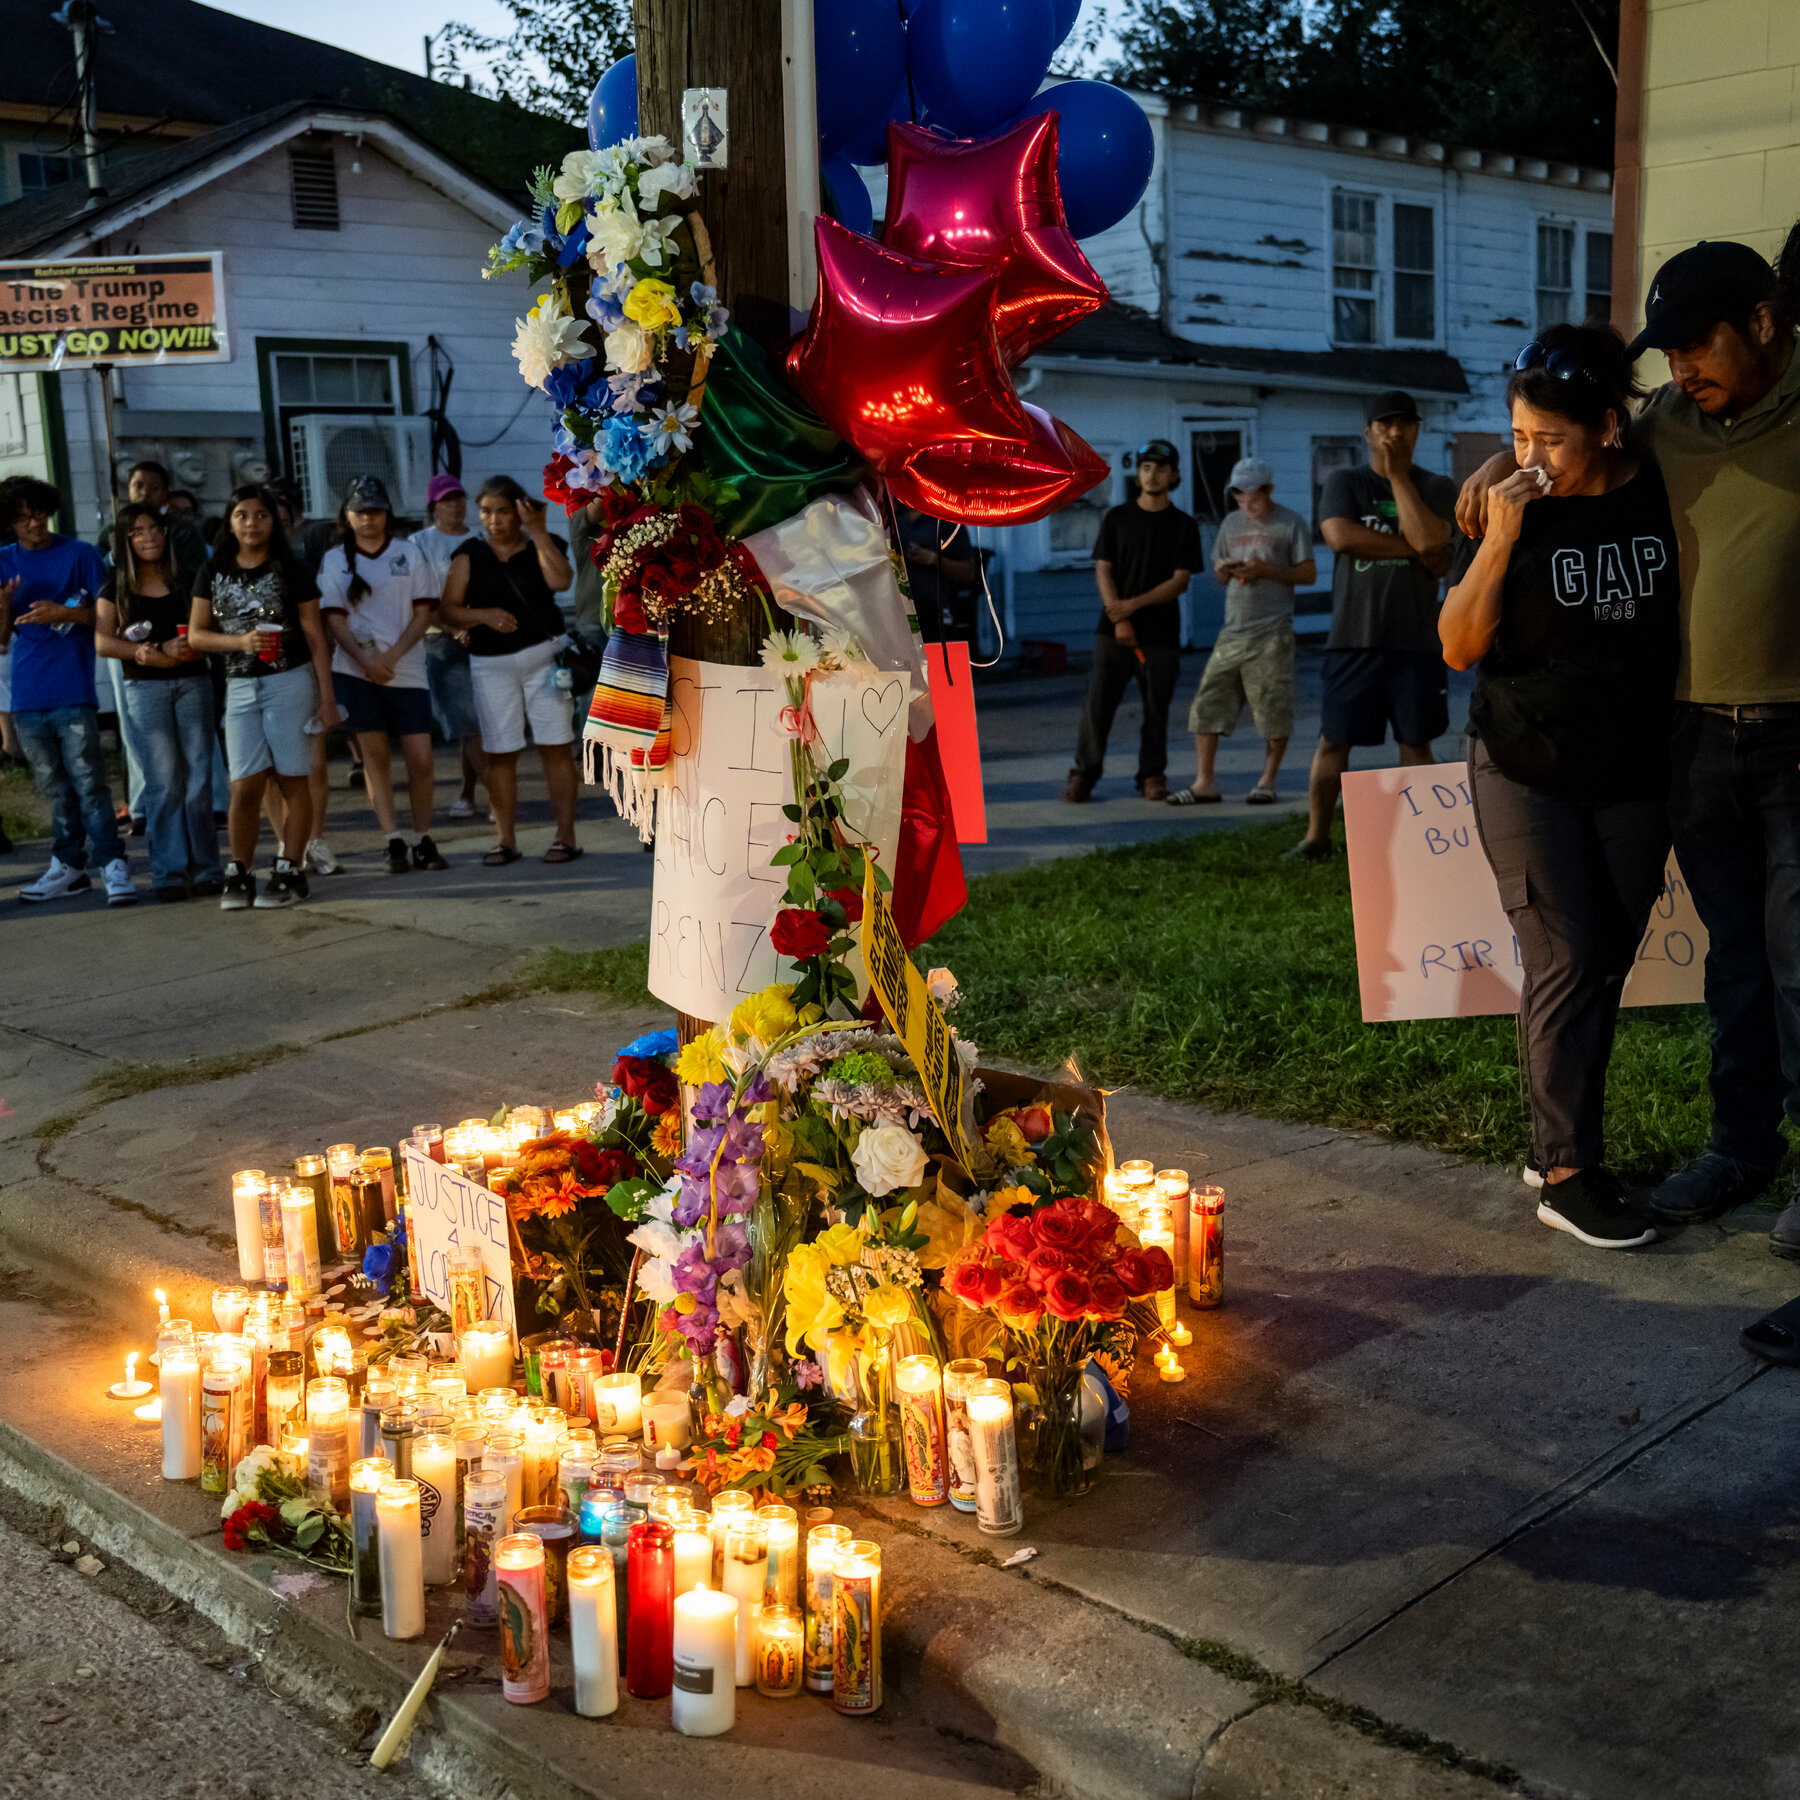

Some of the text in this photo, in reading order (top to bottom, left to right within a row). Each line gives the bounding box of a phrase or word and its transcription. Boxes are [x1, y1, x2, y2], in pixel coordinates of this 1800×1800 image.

[34, 265, 135, 278] RefuseFascism.org
[9, 279, 165, 302] The Trump
[0, 300, 199, 326] ascist Regime
[66, 330, 110, 354] GO
[118, 326, 212, 351] NOW!!!
[1551, 536, 1667, 607] GAP
[1594, 600, 1636, 622] 1969
[1399, 786, 1423, 817] I
[656, 785, 782, 884] ACE
[1424, 824, 1479, 855] BU
[657, 900, 778, 995] RENZ
[408, 1155, 507, 1250] JUSTICE
